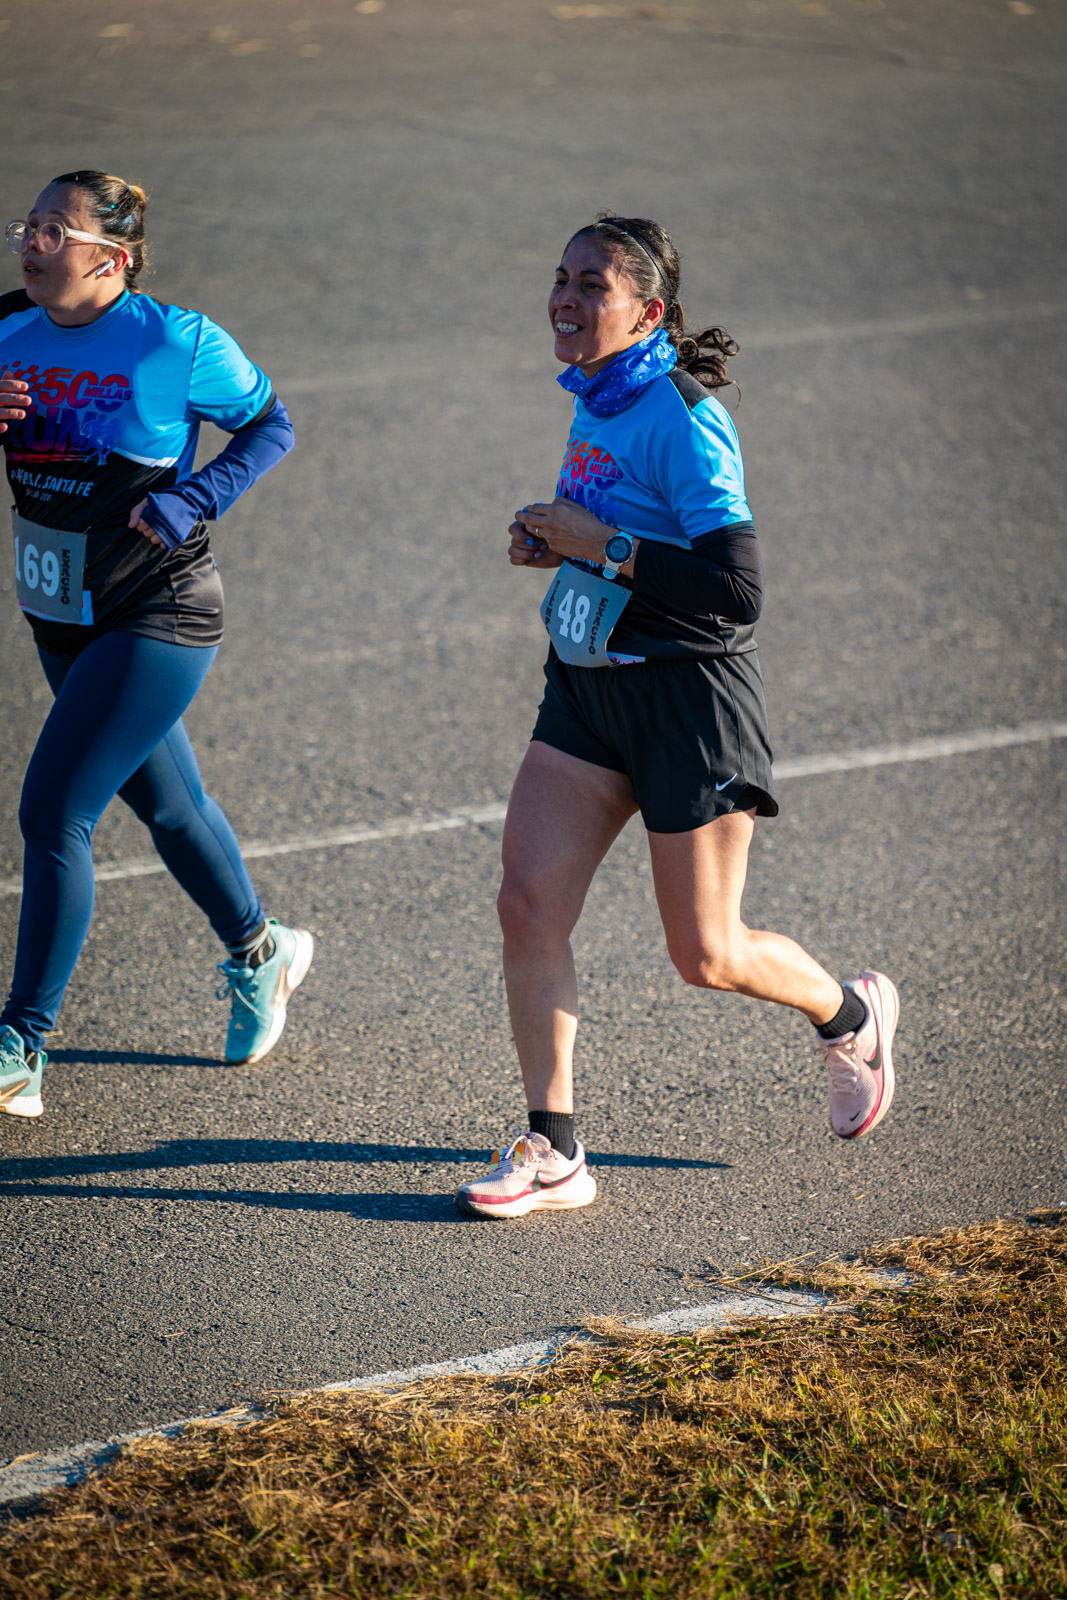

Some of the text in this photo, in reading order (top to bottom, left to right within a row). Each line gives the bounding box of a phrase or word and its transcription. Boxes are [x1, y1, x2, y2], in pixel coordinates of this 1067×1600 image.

[84, 387, 133, 401] MILLAS
[75, 481, 94, 497] FE
[589, 463, 624, 480] MILLAS
[60, 549, 71, 605] EXACTO
[558, 588, 591, 644] 48
[588, 597, 609, 655] EXACTO
